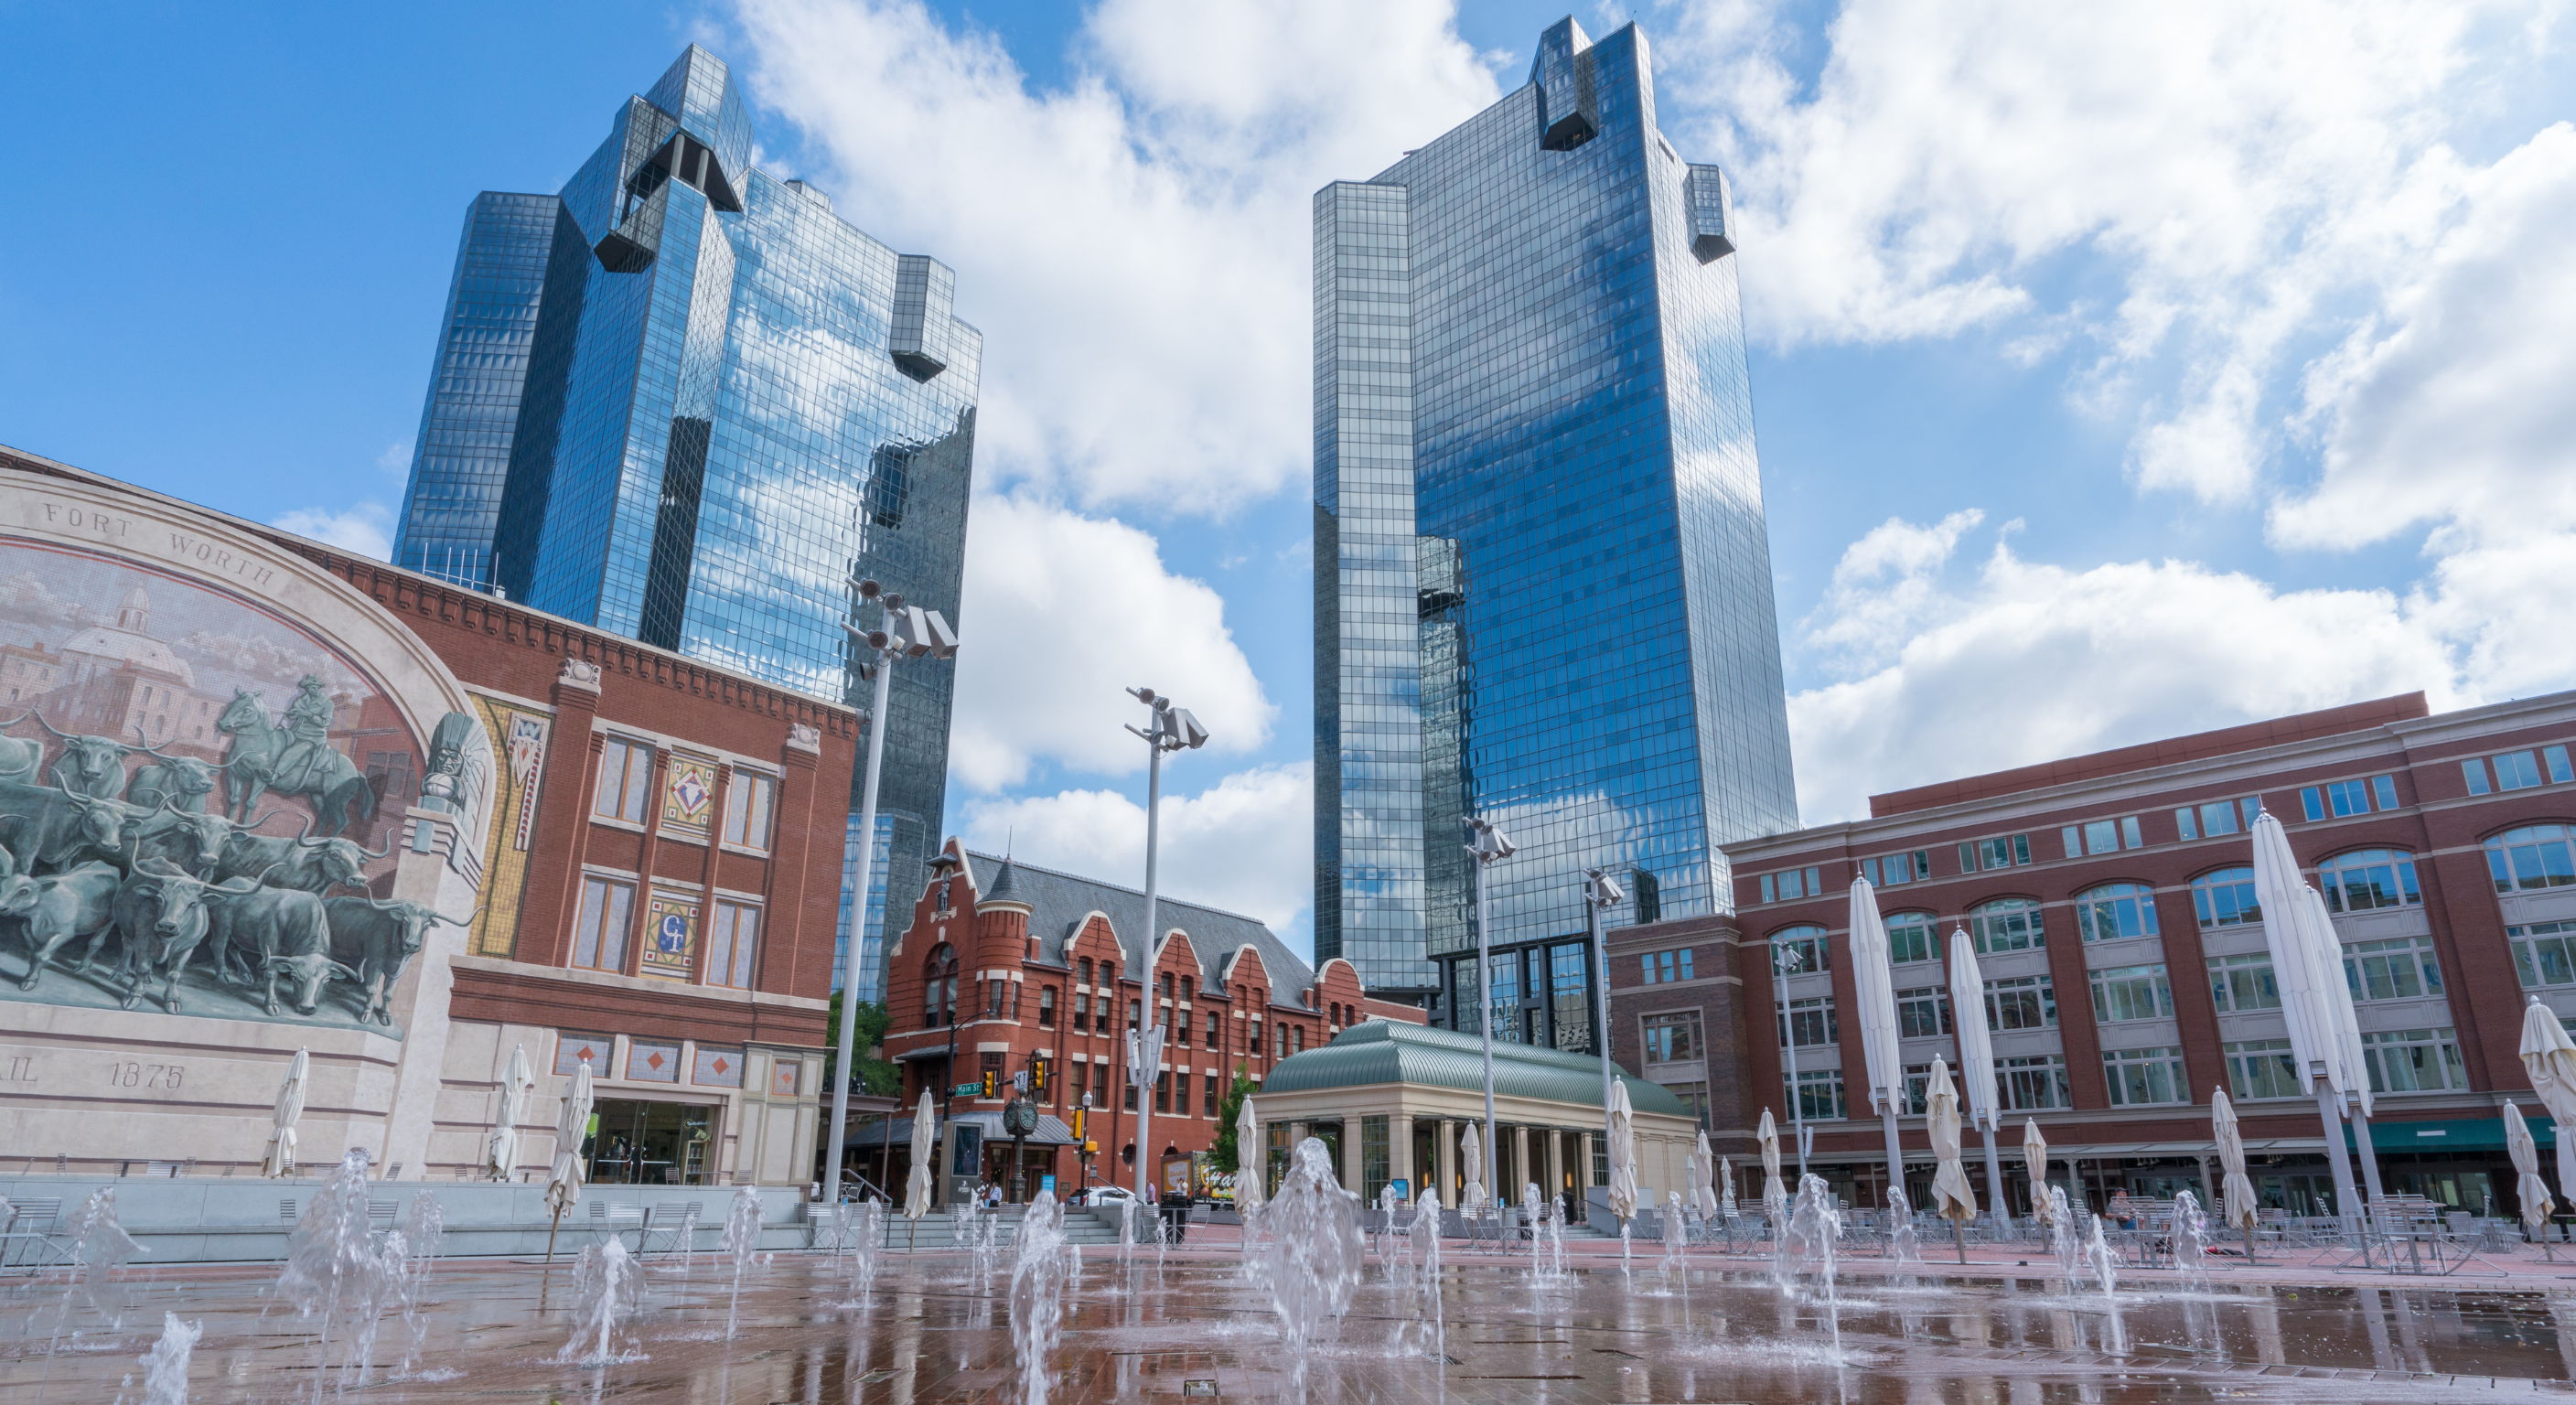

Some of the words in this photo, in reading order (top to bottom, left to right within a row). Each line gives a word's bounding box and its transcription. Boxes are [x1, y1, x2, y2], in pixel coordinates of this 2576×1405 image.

[43, 503, 132, 537] FORT
[170, 532, 274, 586] WORTH
[0, 1056, 38, 1083] IL
[110, 1062, 185, 1089] 1875
[957, 1085, 971, 1093] Main
